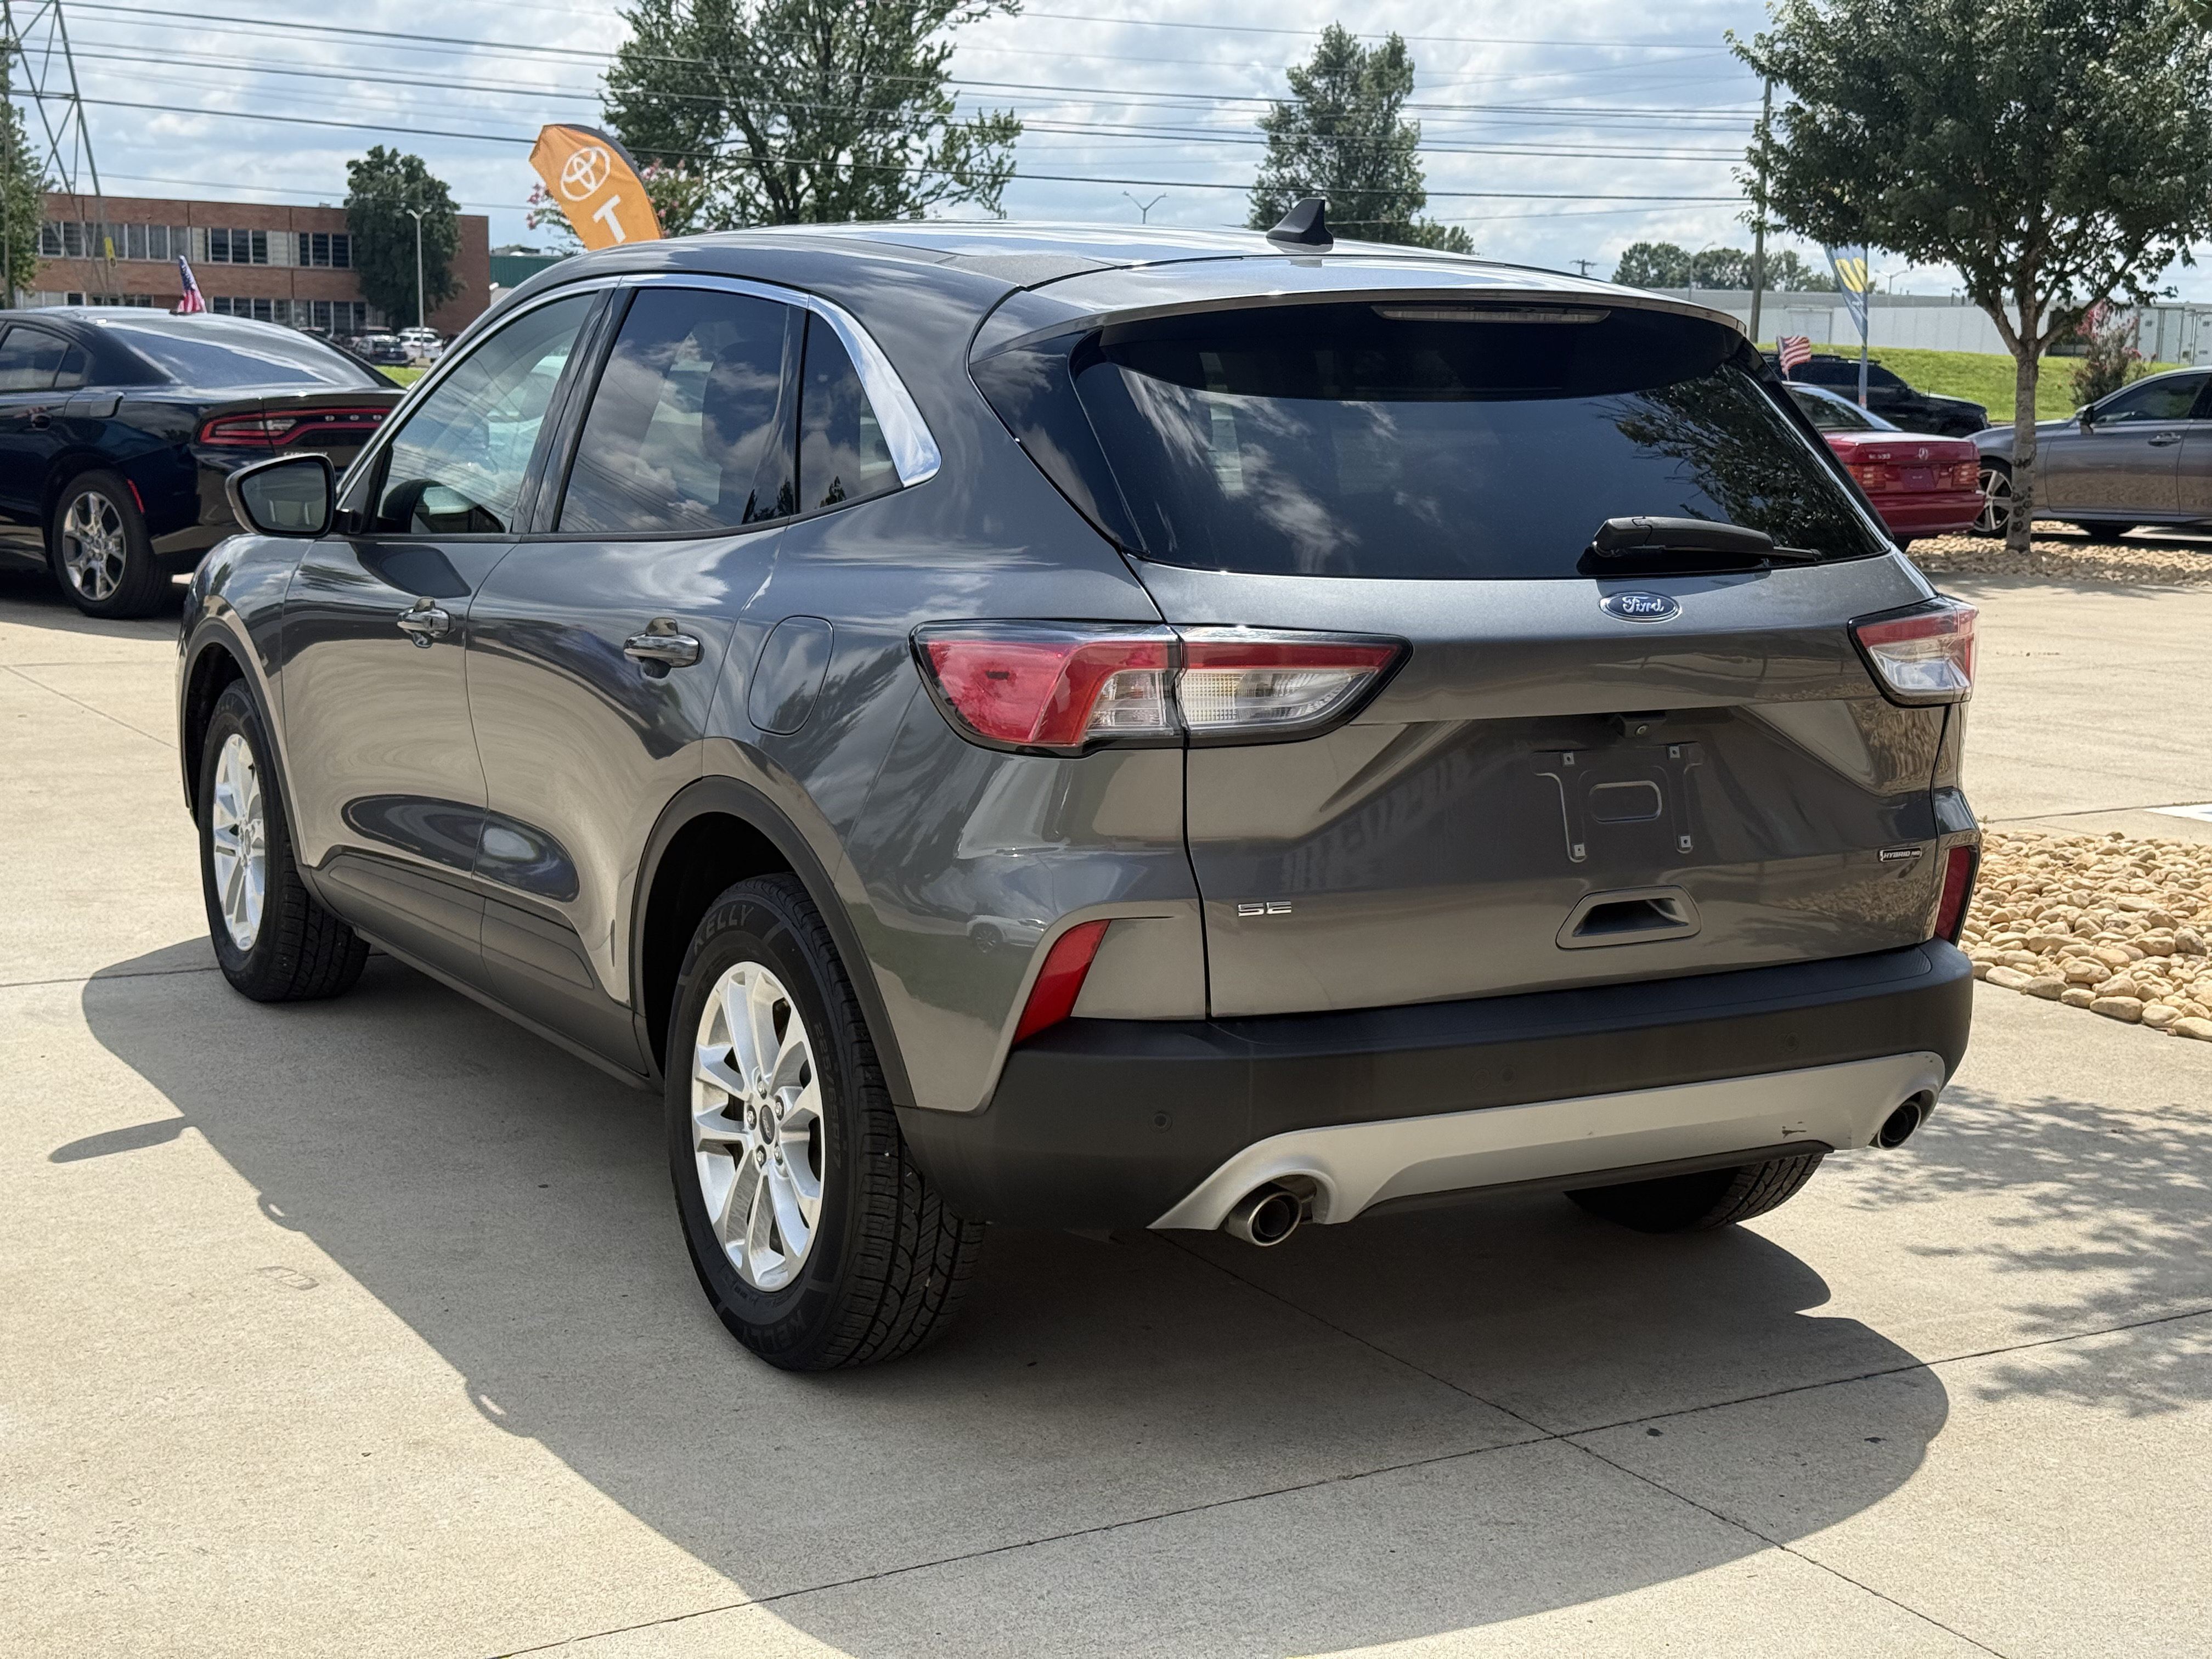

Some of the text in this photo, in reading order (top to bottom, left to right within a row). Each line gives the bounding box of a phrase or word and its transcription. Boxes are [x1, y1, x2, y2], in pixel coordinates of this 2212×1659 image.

[592, 194, 627, 244] T
[1622, 596, 1664, 613] Ford
[1883, 850, 1911, 859] HYBRID
[1238, 901, 1293, 917] SE
[693, 904, 755, 956] KELLY
